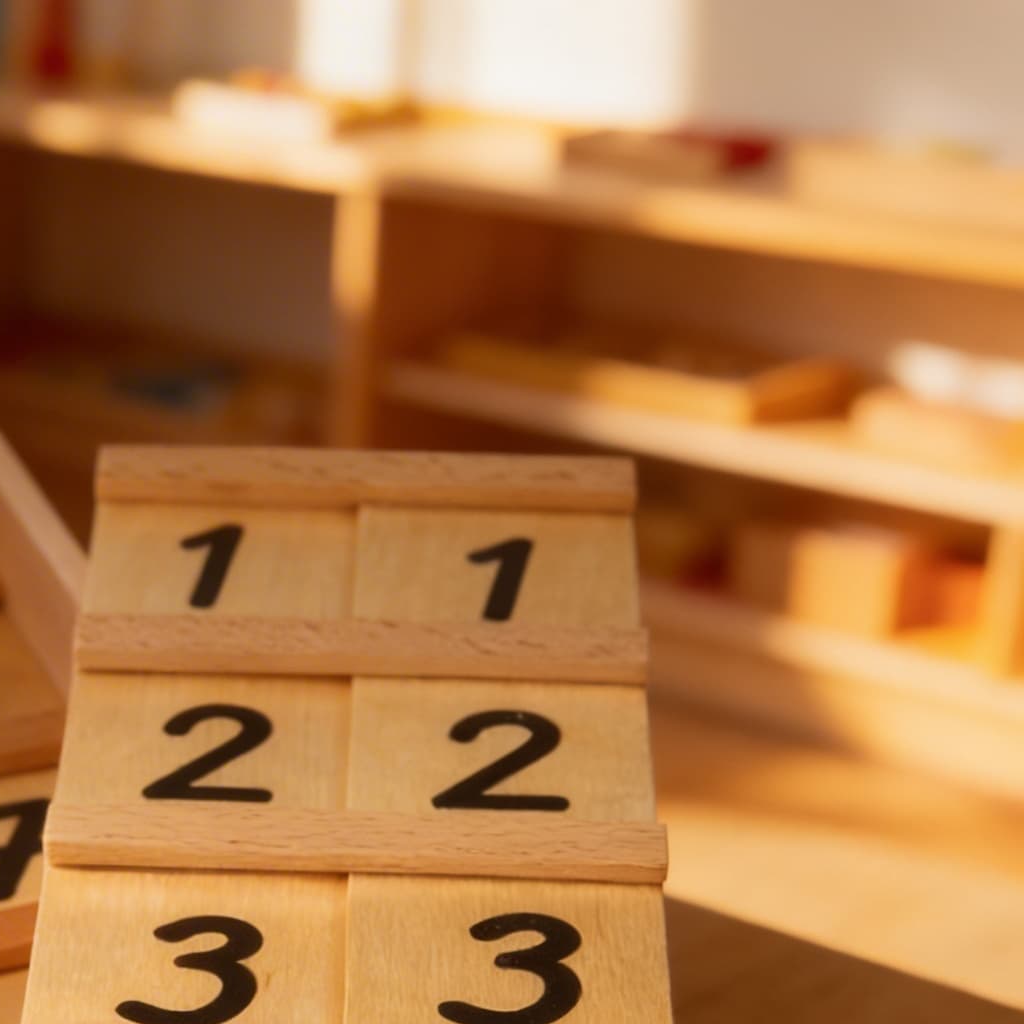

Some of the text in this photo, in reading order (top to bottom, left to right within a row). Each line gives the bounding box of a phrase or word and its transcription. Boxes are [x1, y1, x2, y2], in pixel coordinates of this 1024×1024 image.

[179, 523, 535, 622] 1 1
[143, 704, 570, 812] 2 2
